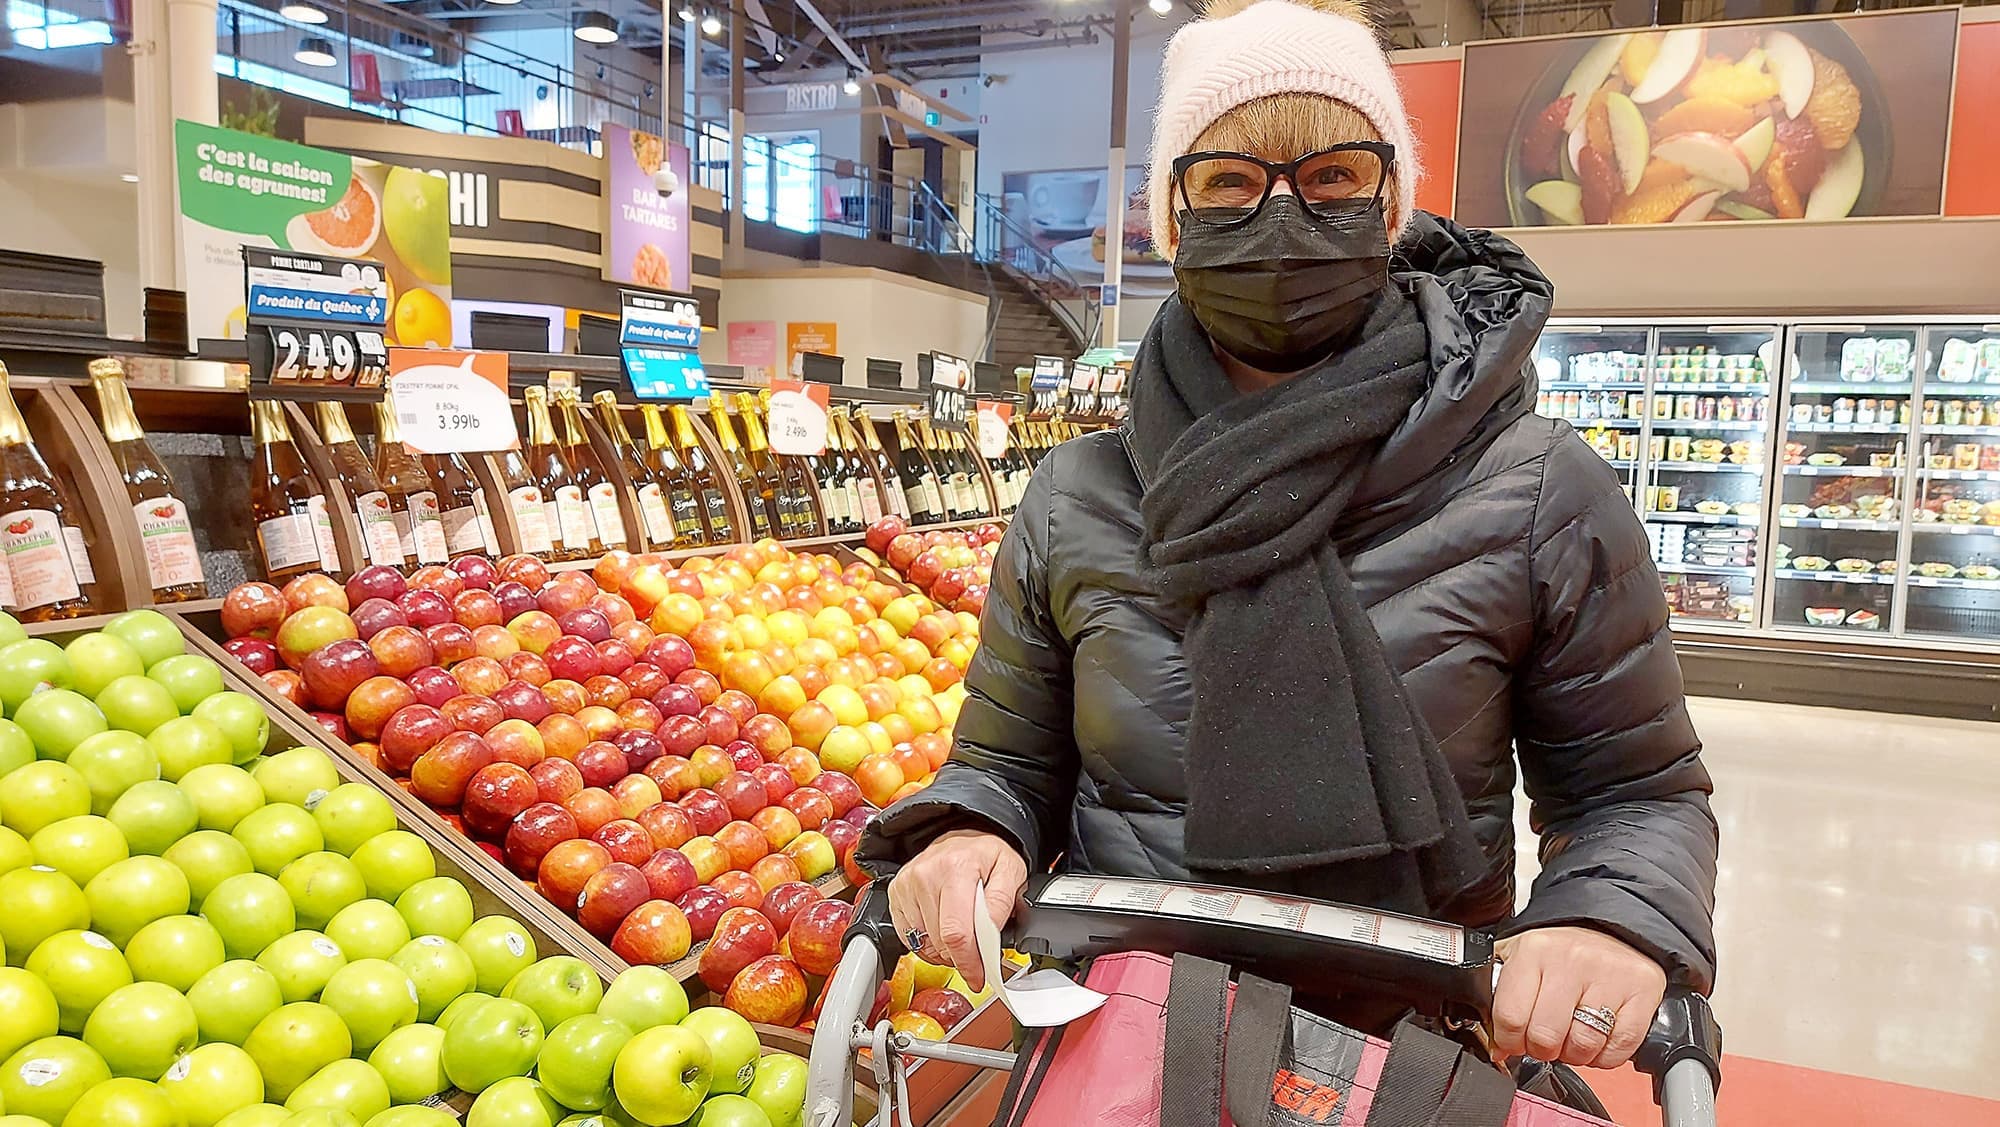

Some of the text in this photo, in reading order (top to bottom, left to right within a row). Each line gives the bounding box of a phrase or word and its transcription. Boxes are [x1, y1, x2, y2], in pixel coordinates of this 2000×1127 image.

[787, 84, 837, 110] BISTRO
[197, 143, 333, 185] C'est la saison
[199, 164, 327, 203] des agrumes!
[632, 188, 656, 207] BAR
[622, 204, 678, 232] TARTARES
[257, 294, 363, 314] Produit du Québec
[438, 414, 480, 430] 3.99lb
